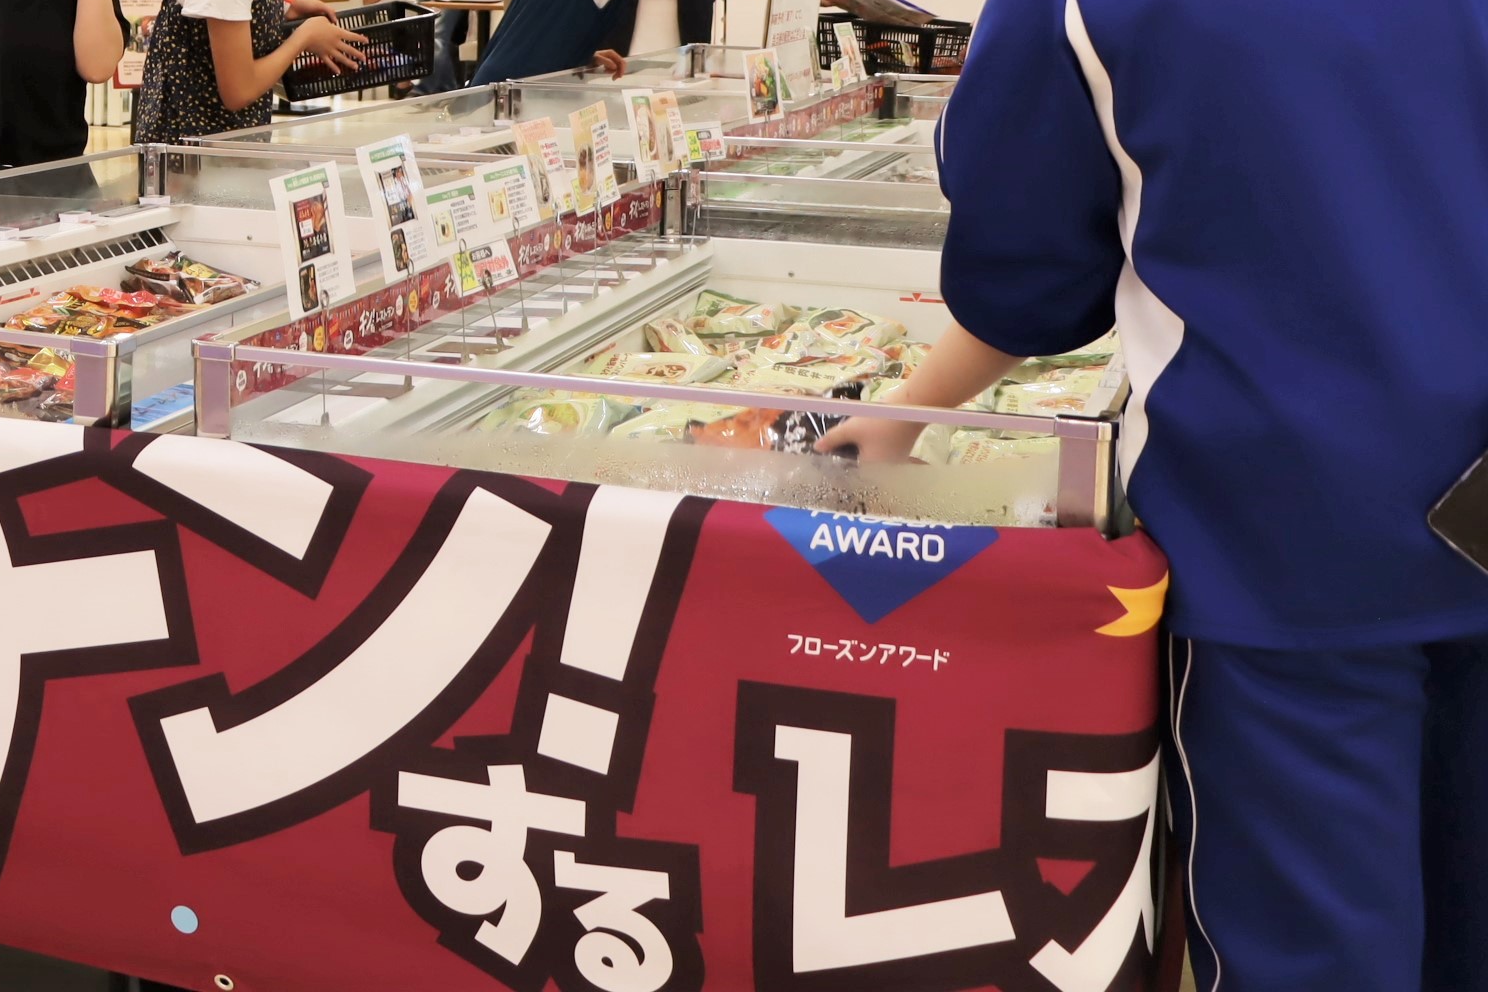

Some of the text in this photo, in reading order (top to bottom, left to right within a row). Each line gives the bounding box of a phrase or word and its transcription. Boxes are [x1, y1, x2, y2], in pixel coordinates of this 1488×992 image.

[810, 524, 945, 563] AWARD
[787, 633, 951, 672] フローズンアワード
[397, 763, 673, 992] する
